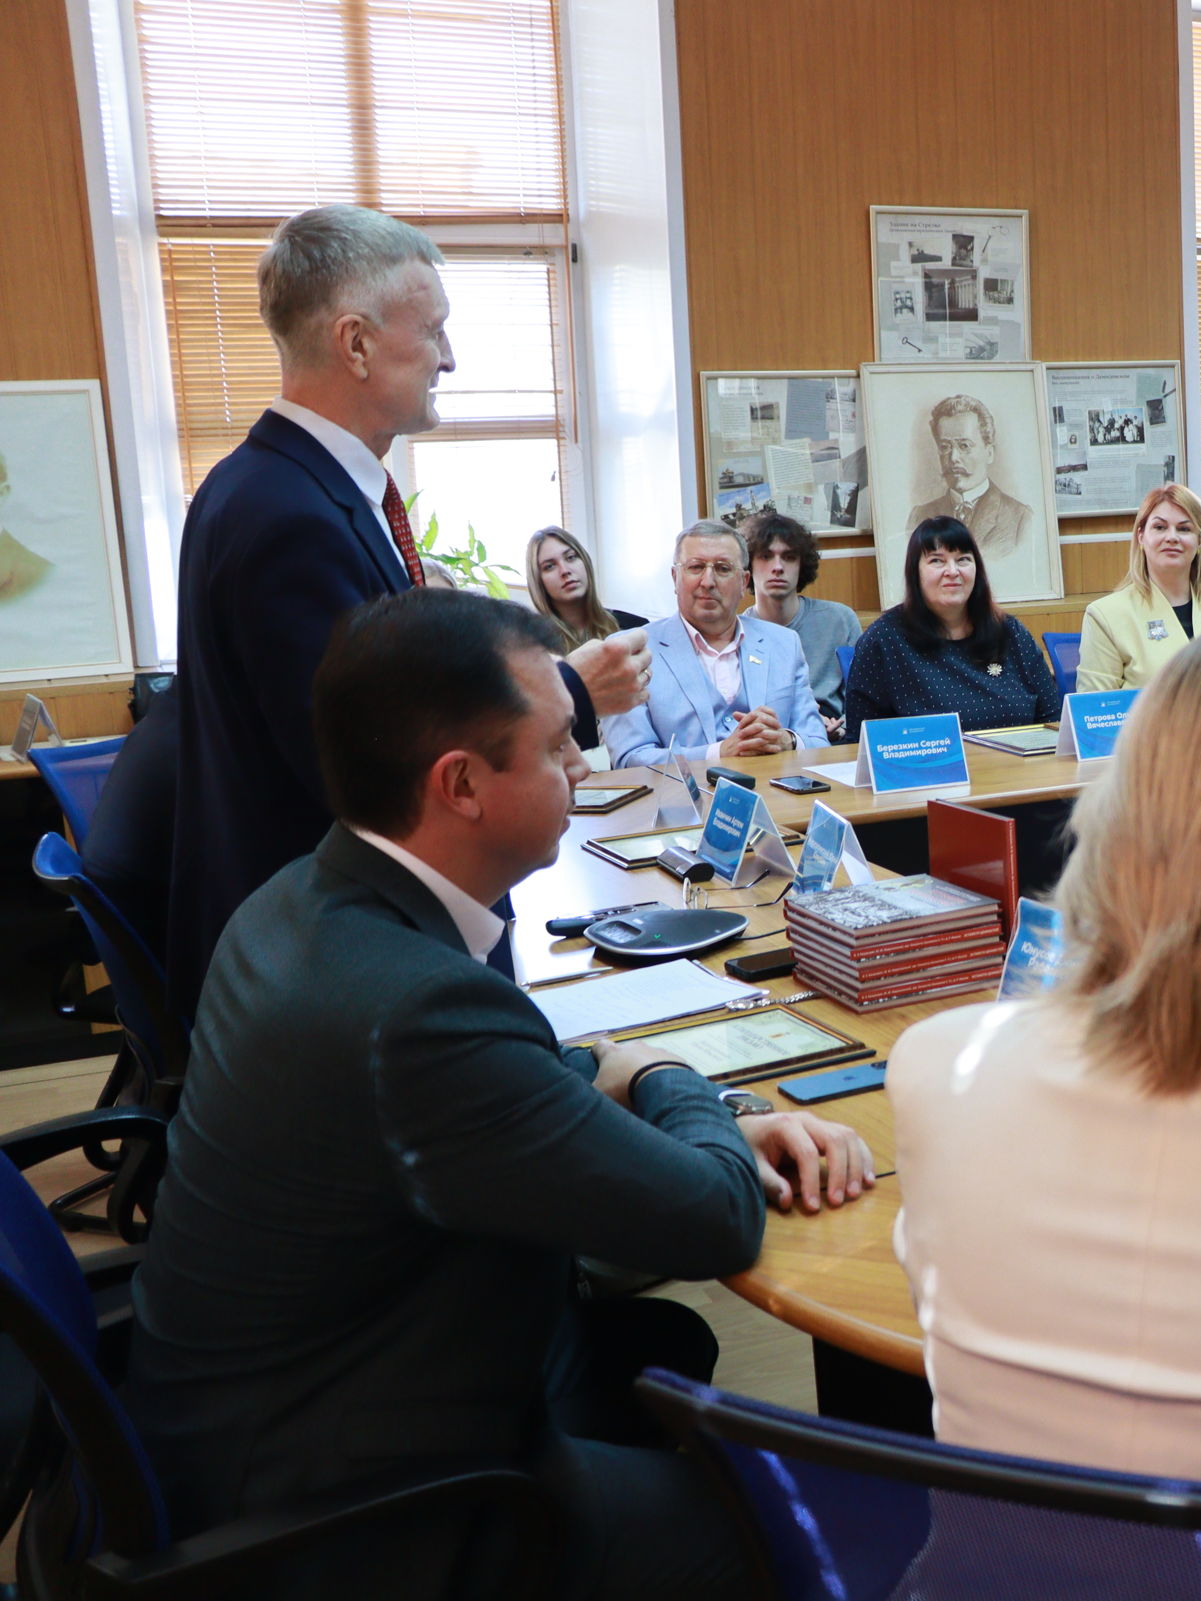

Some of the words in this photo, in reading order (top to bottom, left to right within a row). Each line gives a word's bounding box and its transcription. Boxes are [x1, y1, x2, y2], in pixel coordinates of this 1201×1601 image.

[1084, 713, 1115, 723] Петрова
[877, 741, 919, 753] Березкин
[920, 737, 951, 749] Сергей
[882, 746, 948, 759] Владимирович
